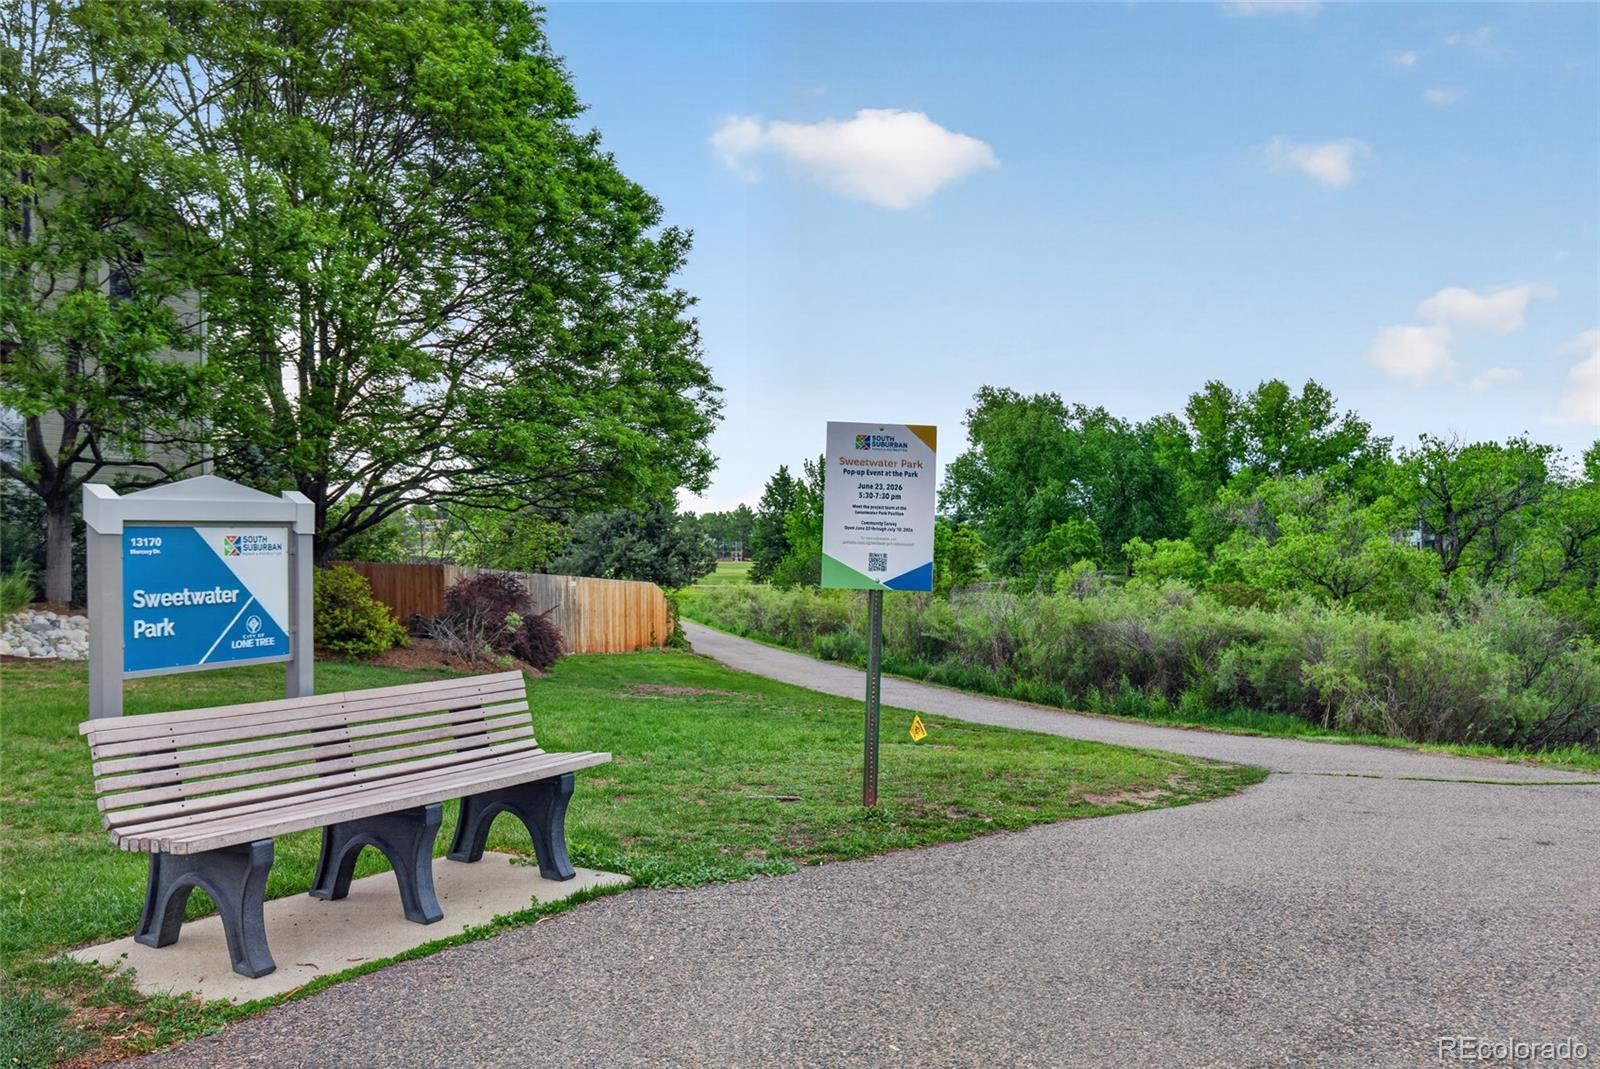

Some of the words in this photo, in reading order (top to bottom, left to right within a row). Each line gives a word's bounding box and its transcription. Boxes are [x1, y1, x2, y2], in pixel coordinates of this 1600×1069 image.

[840, 457, 898, 468] Sweetwater
[901, 459, 924, 469] Park
[843, 468, 865, 477] Pop-up
[875, 483, 885, 491] 23,
[130, 537, 162, 546] 13170
[132, 586, 240, 608] Sweetwater
[134, 618, 175, 639] Park
[232, 638, 254, 649] LONE
[254, 637, 275, 646] TREE
